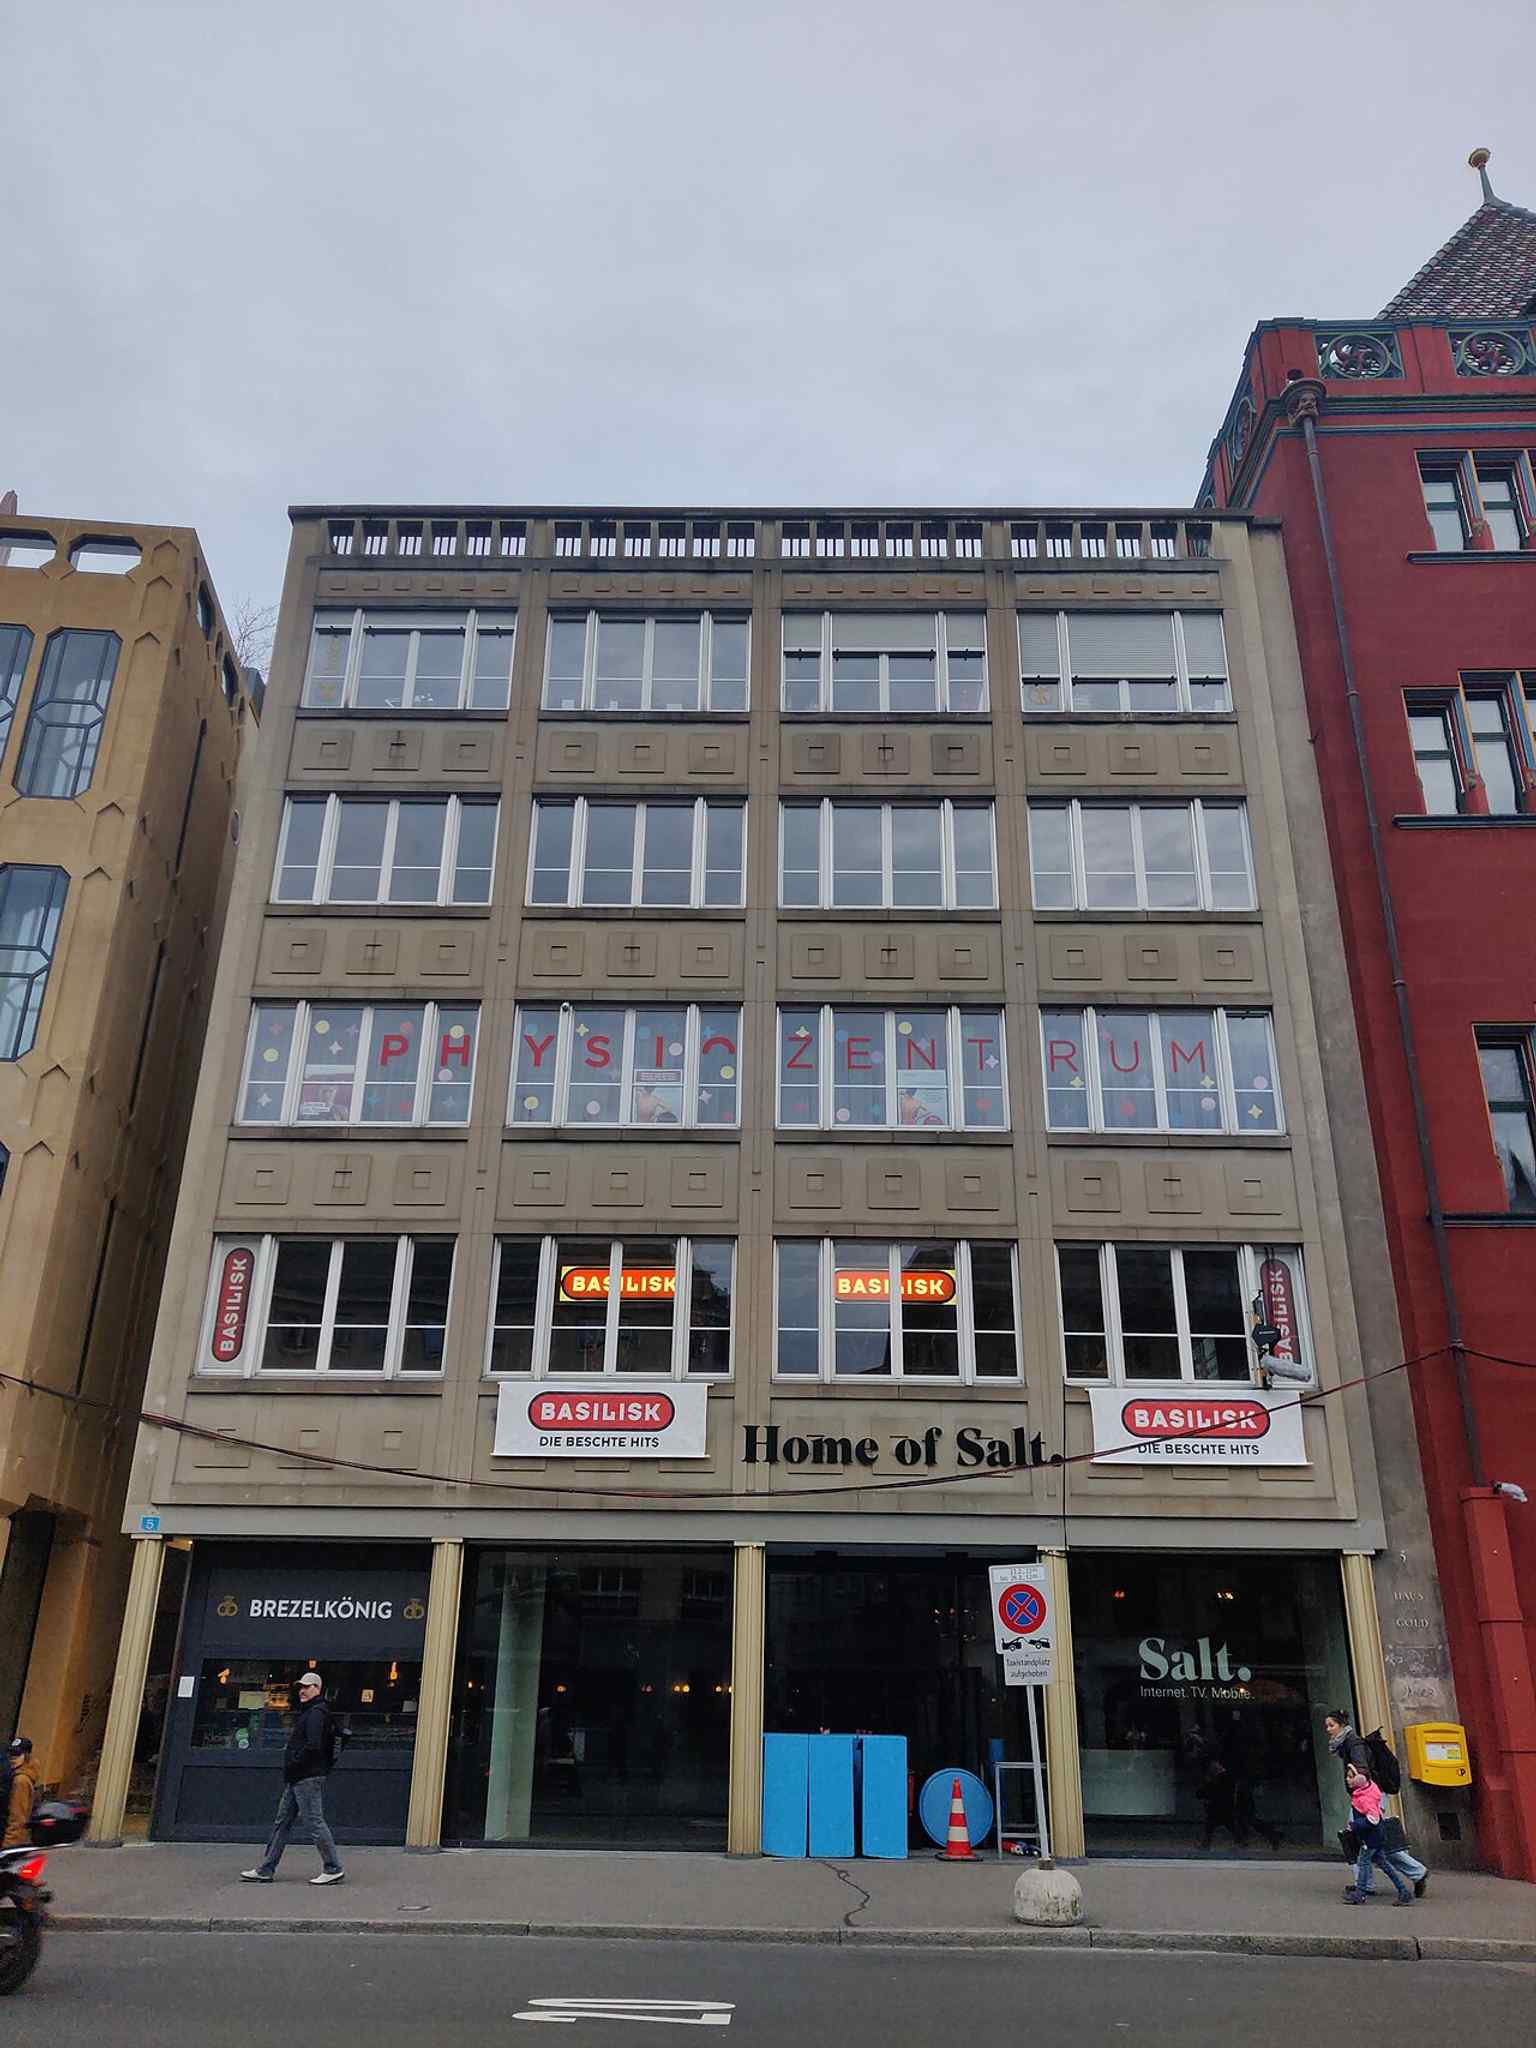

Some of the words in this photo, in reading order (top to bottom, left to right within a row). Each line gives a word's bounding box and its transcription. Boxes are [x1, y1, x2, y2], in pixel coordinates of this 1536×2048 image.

[786, 1035, 1209, 1074] ZENTRUM
[837, 1278, 945, 1296] BASIISK
[219, 1257, 248, 1352] BASILISK
[540, 1402, 661, 1422] BASILISK
[1133, 1407, 1259, 1430] BASILISK
[539, 1435, 561, 1448] DIE
[566, 1436, 626, 1448] BESCHTE
[630, 1436, 660, 1449] HITS
[742, 1424, 880, 1467] Home
[894, 1426, 943, 1467] of
[956, 1426, 1064, 1468] Salt.
[1137, 1442, 1161, 1455] DIE
[1165, 1443, 1227, 1456] BESCHTE
[1230, 1443, 1261, 1456] HITS
[248, 1596, 393, 1620] BREZELKÖNIG
[1137, 1636, 1252, 1683] Salt.
